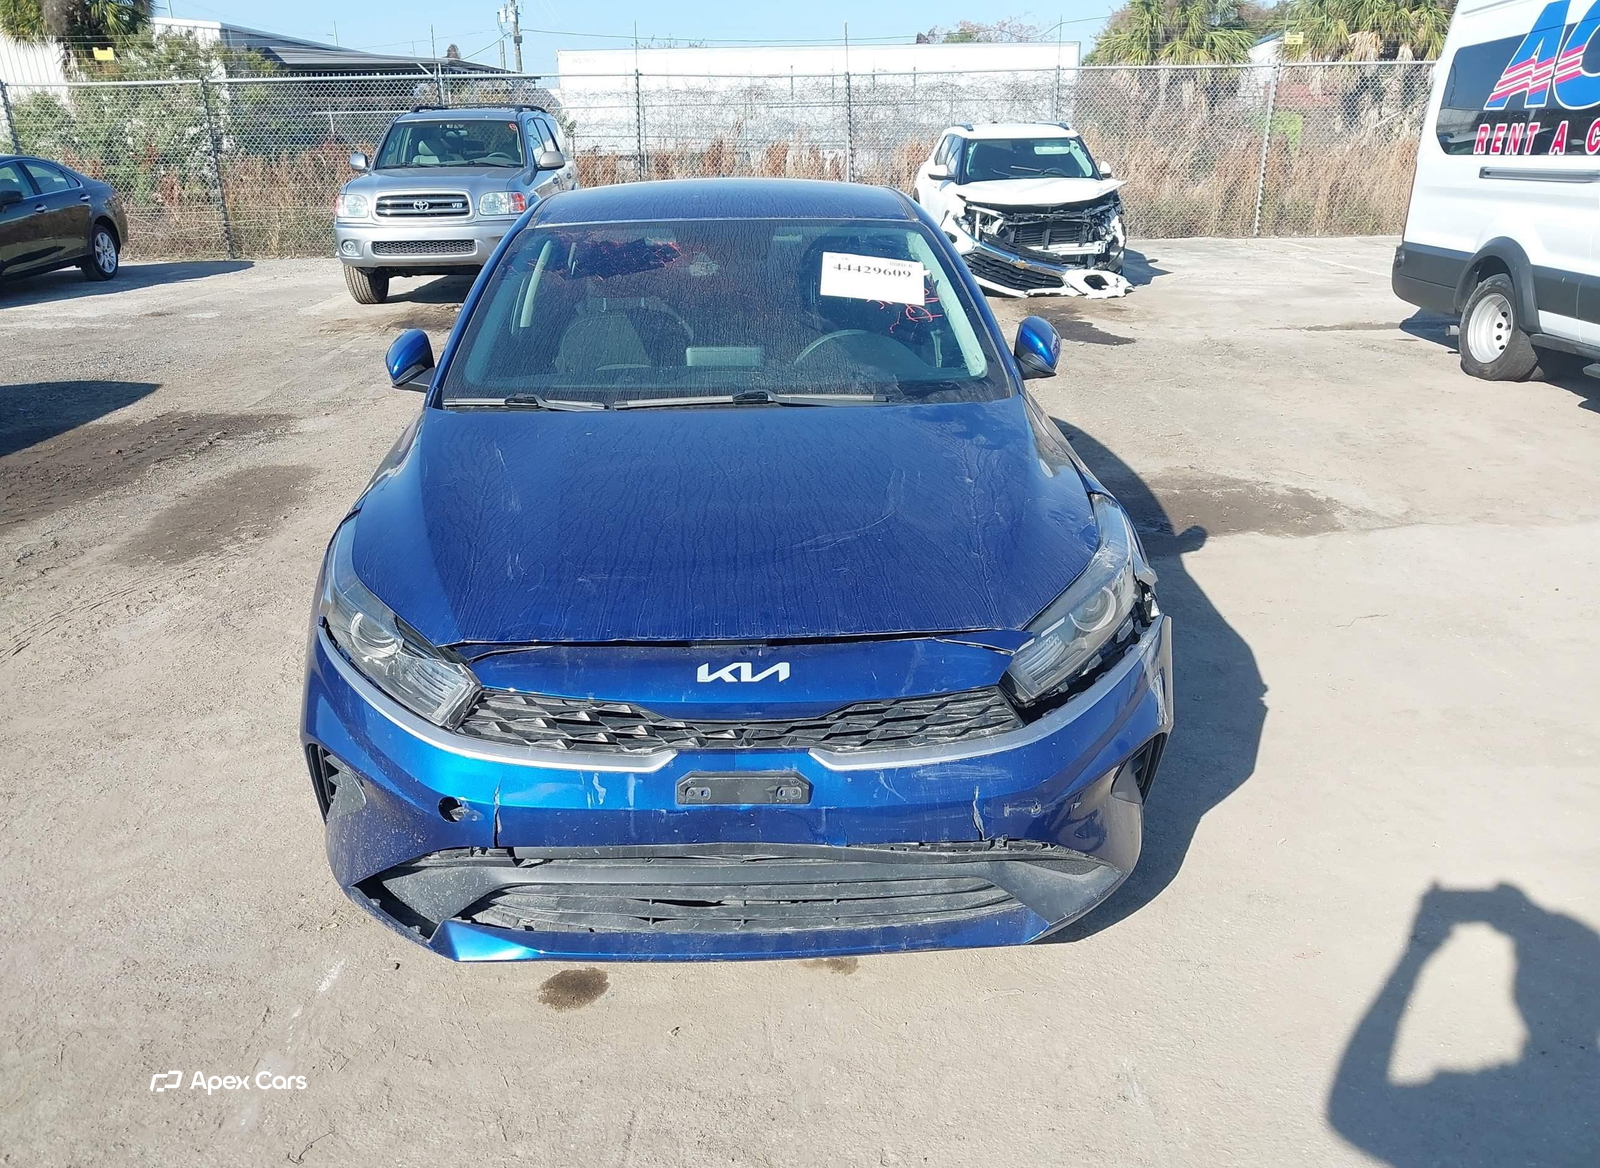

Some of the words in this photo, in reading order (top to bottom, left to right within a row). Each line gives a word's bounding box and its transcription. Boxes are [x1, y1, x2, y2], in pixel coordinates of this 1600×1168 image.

[1473, 122, 1540, 155] RENT
[1549, 120, 1569, 155] A
[833, 263, 912, 278] 44429609
[696, 662, 790, 682] KIA
